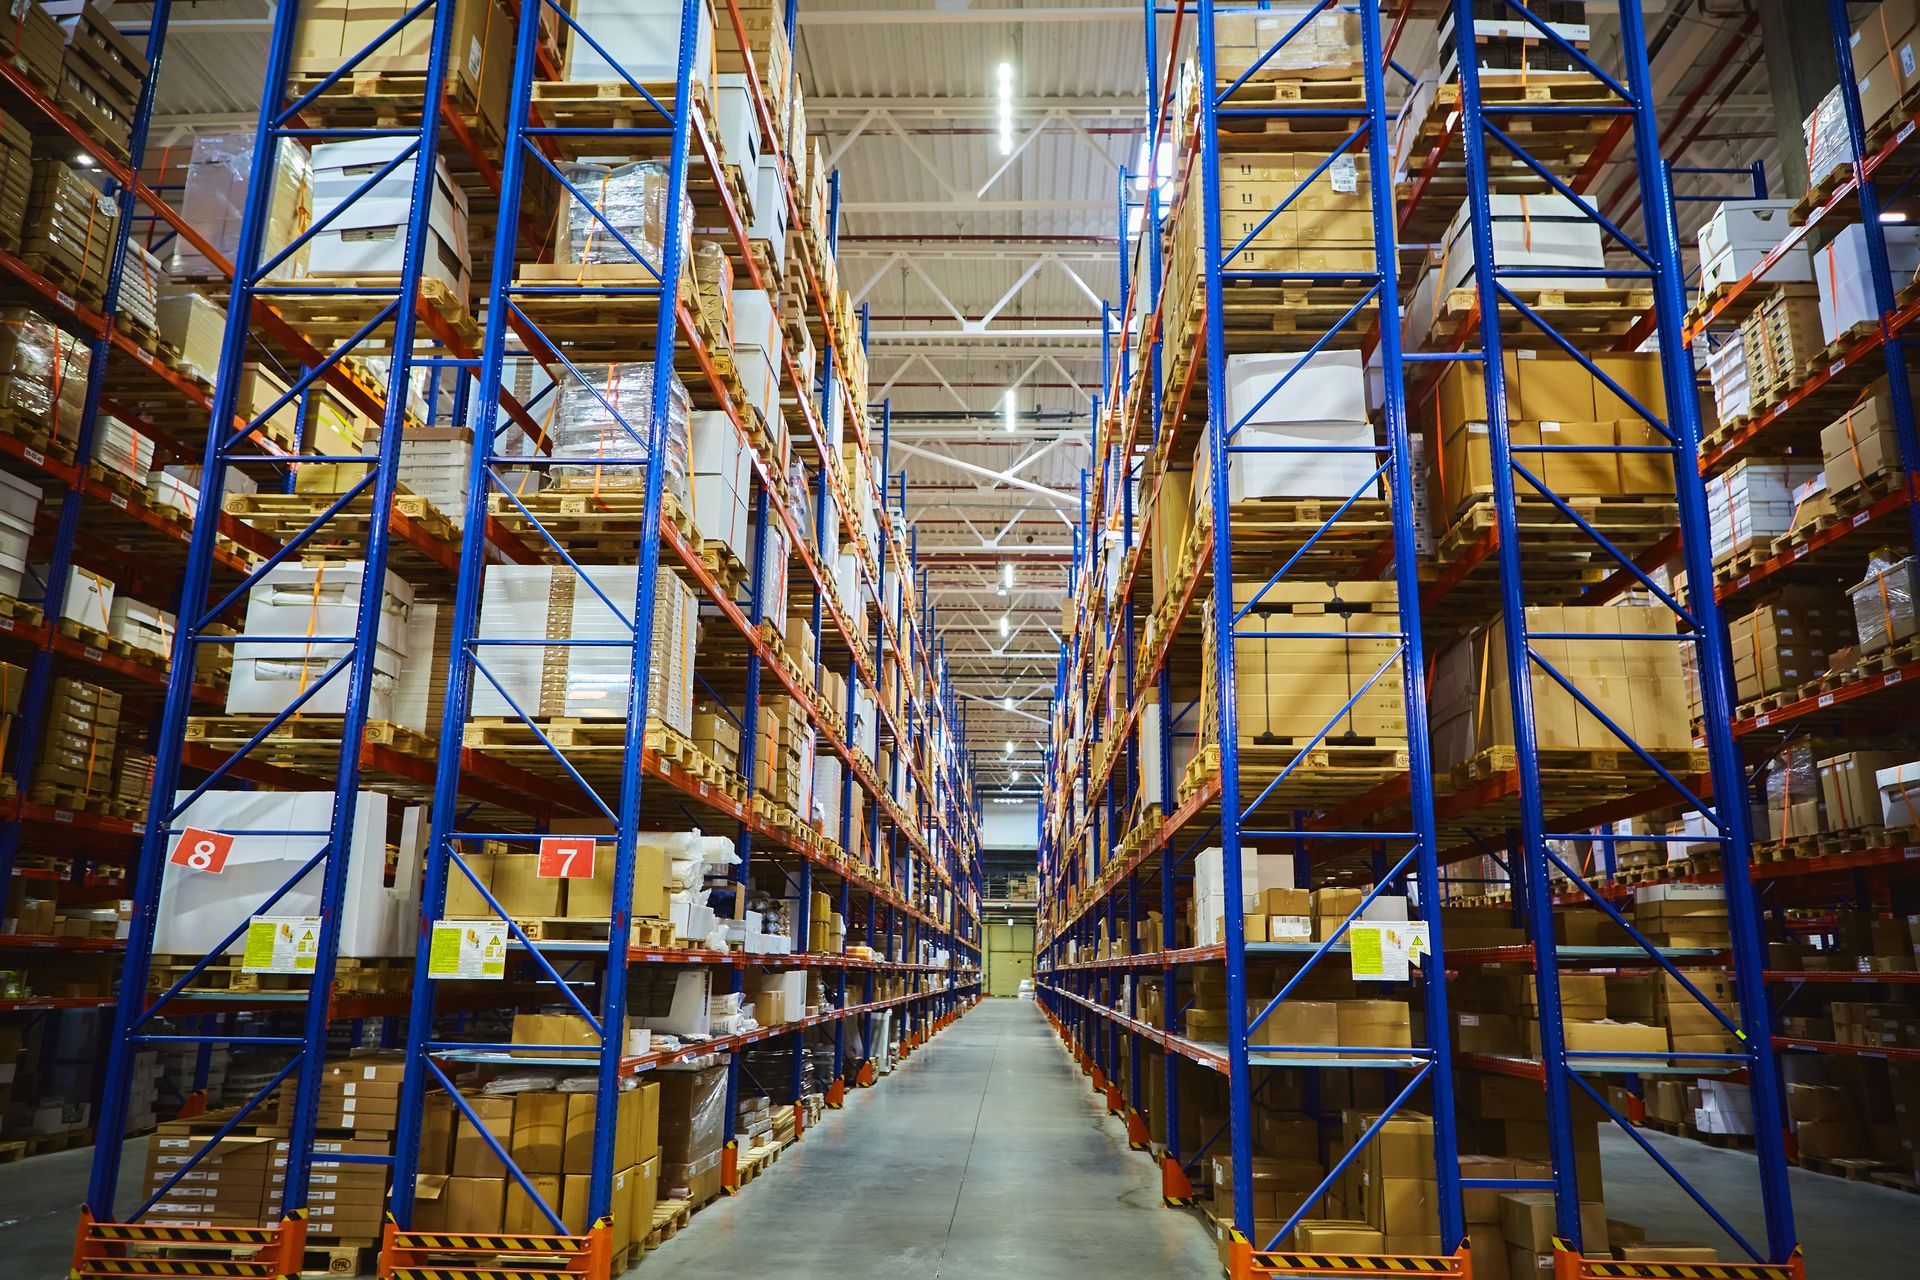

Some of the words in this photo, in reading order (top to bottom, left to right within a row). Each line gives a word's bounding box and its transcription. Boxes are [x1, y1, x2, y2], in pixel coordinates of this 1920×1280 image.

[187, 840, 216, 870] 8
[557, 848, 578, 877] 7
[334, 1260, 348, 1269] EPAL
